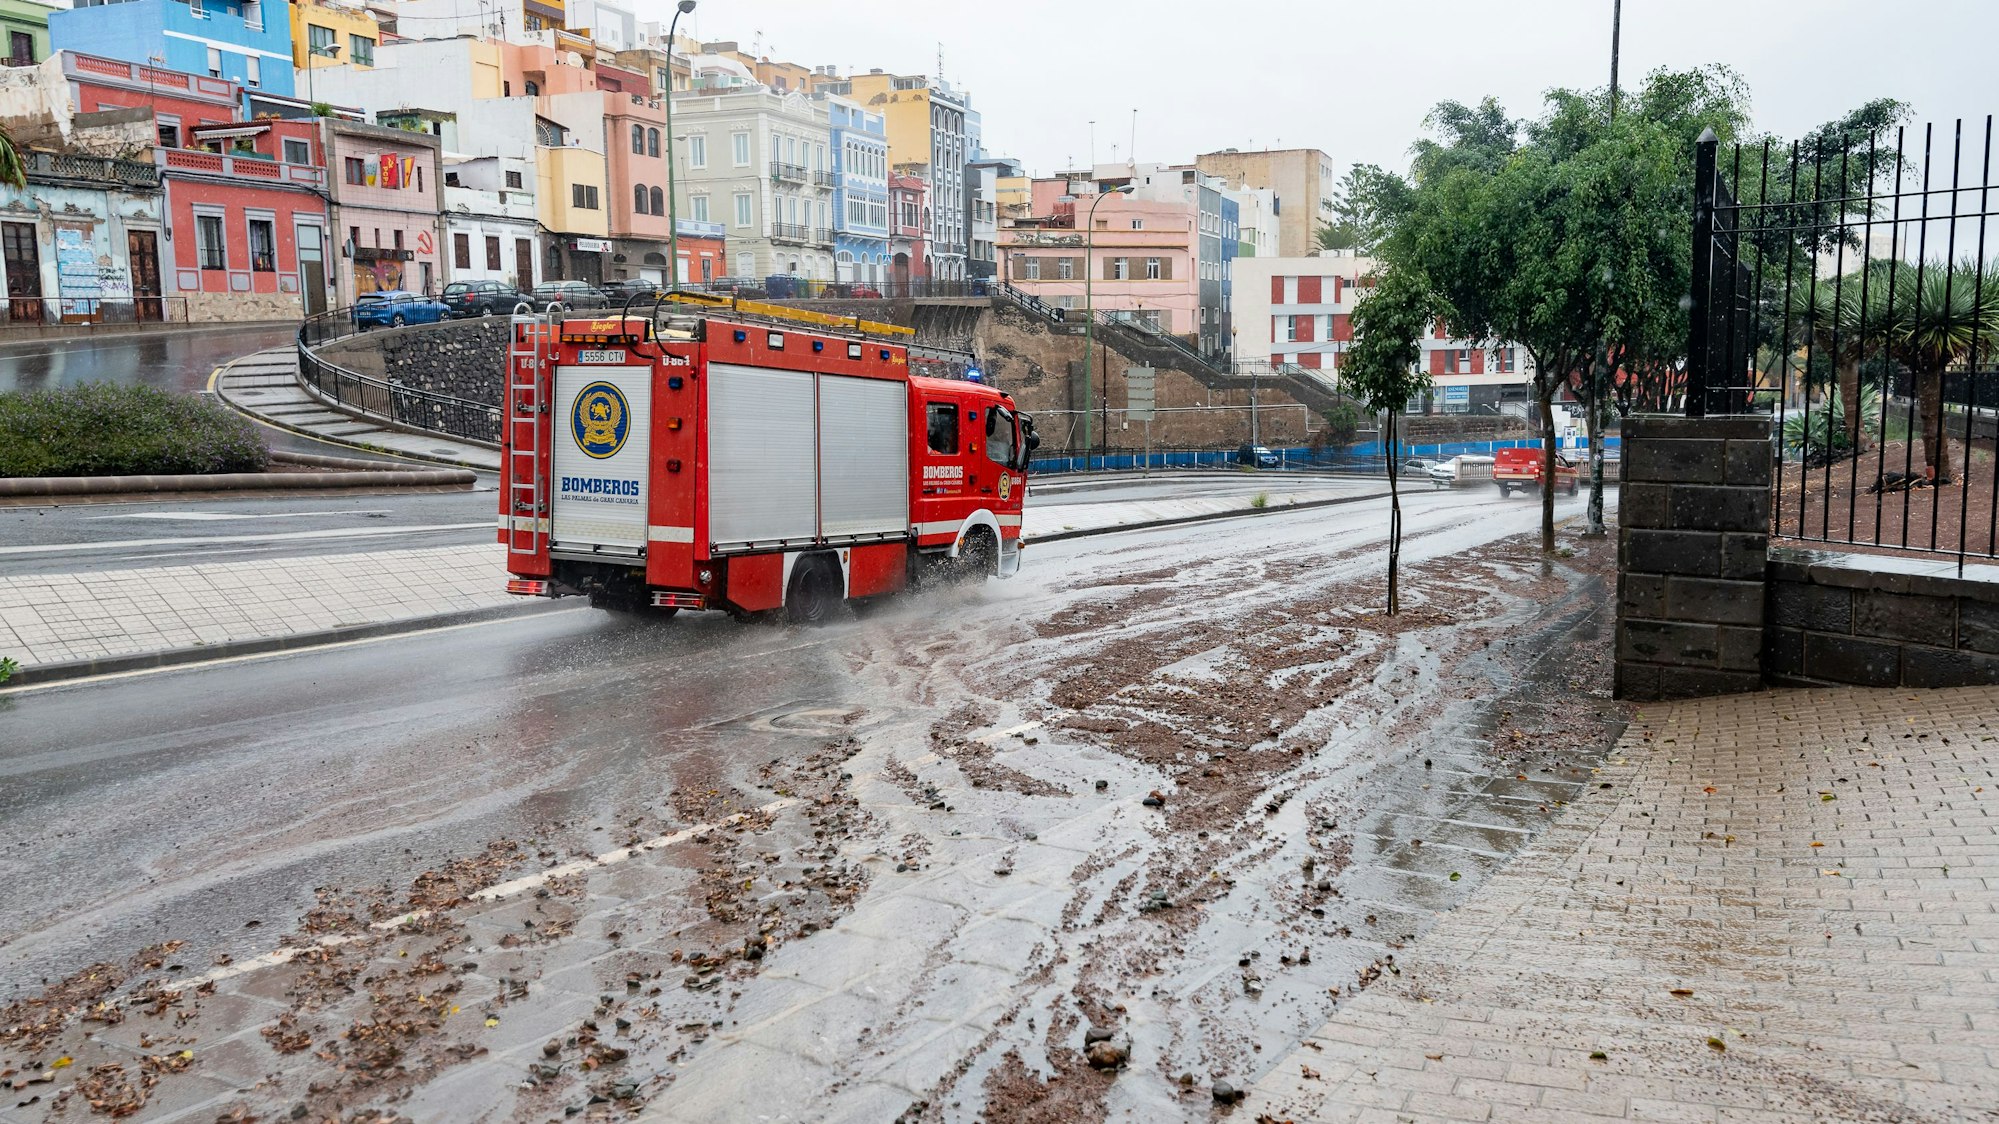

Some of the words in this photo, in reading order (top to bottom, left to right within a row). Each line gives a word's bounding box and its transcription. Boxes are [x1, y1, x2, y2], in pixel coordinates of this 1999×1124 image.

[590, 321, 616, 333] Ziegler
[584, 351, 604, 362] 5556
[608, 351, 625, 362] CTV
[520, 358, 545, 369] U-84
[923, 466, 963, 479] BOMBEROS
[561, 477, 639, 496] BOMBEROS
